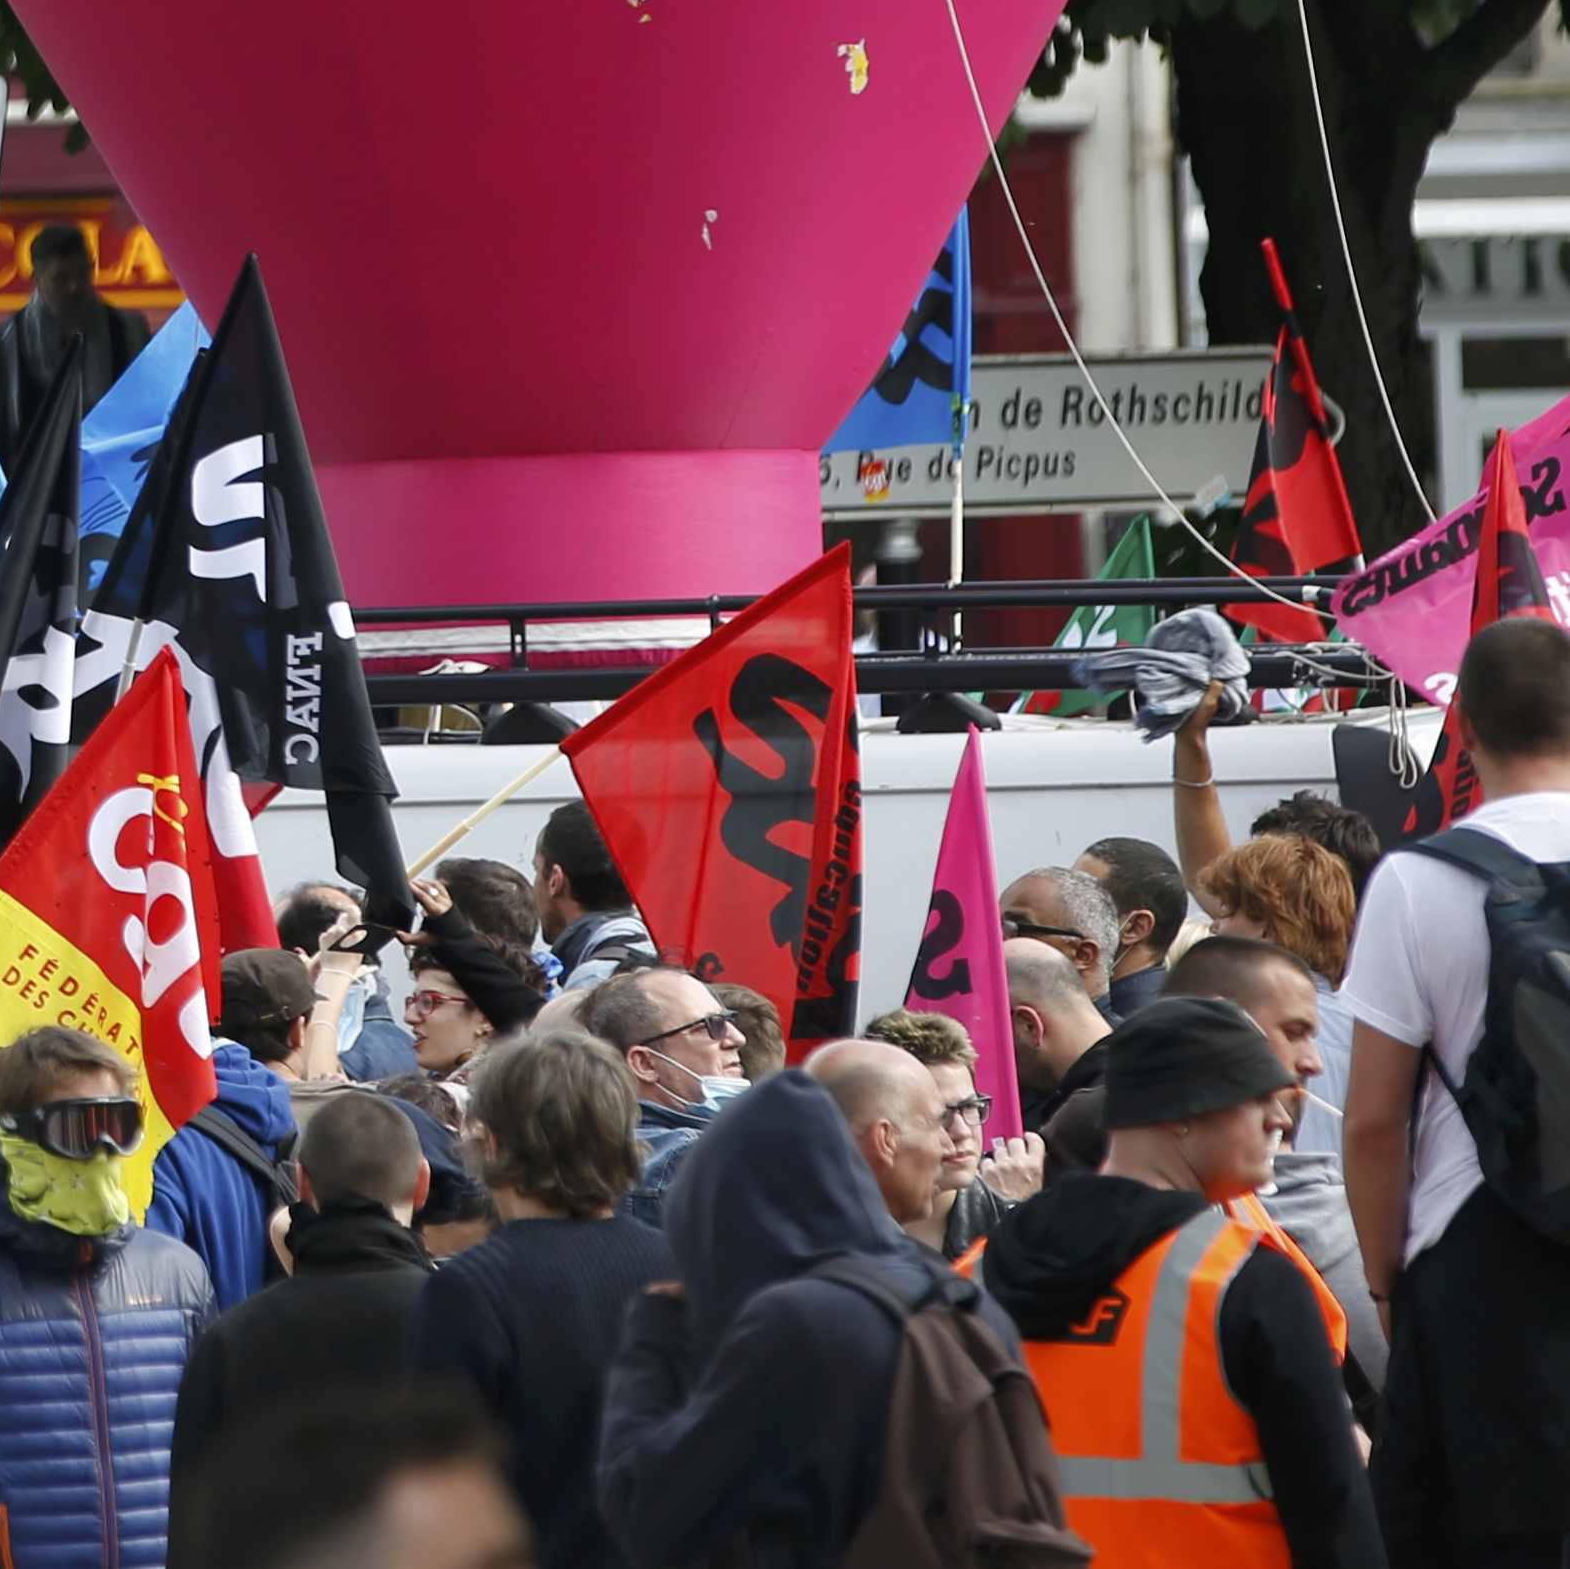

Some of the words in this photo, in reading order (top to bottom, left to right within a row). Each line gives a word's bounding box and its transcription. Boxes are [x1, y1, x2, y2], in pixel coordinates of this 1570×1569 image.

[999, 388, 1043, 430] de
[1060, 379, 1266, 429] Rothschild
[974, 446, 1077, 486] Picpus
[1, 965, 51, 1011] DES
[18, 942, 141, 1057] FÉDÉRAT
